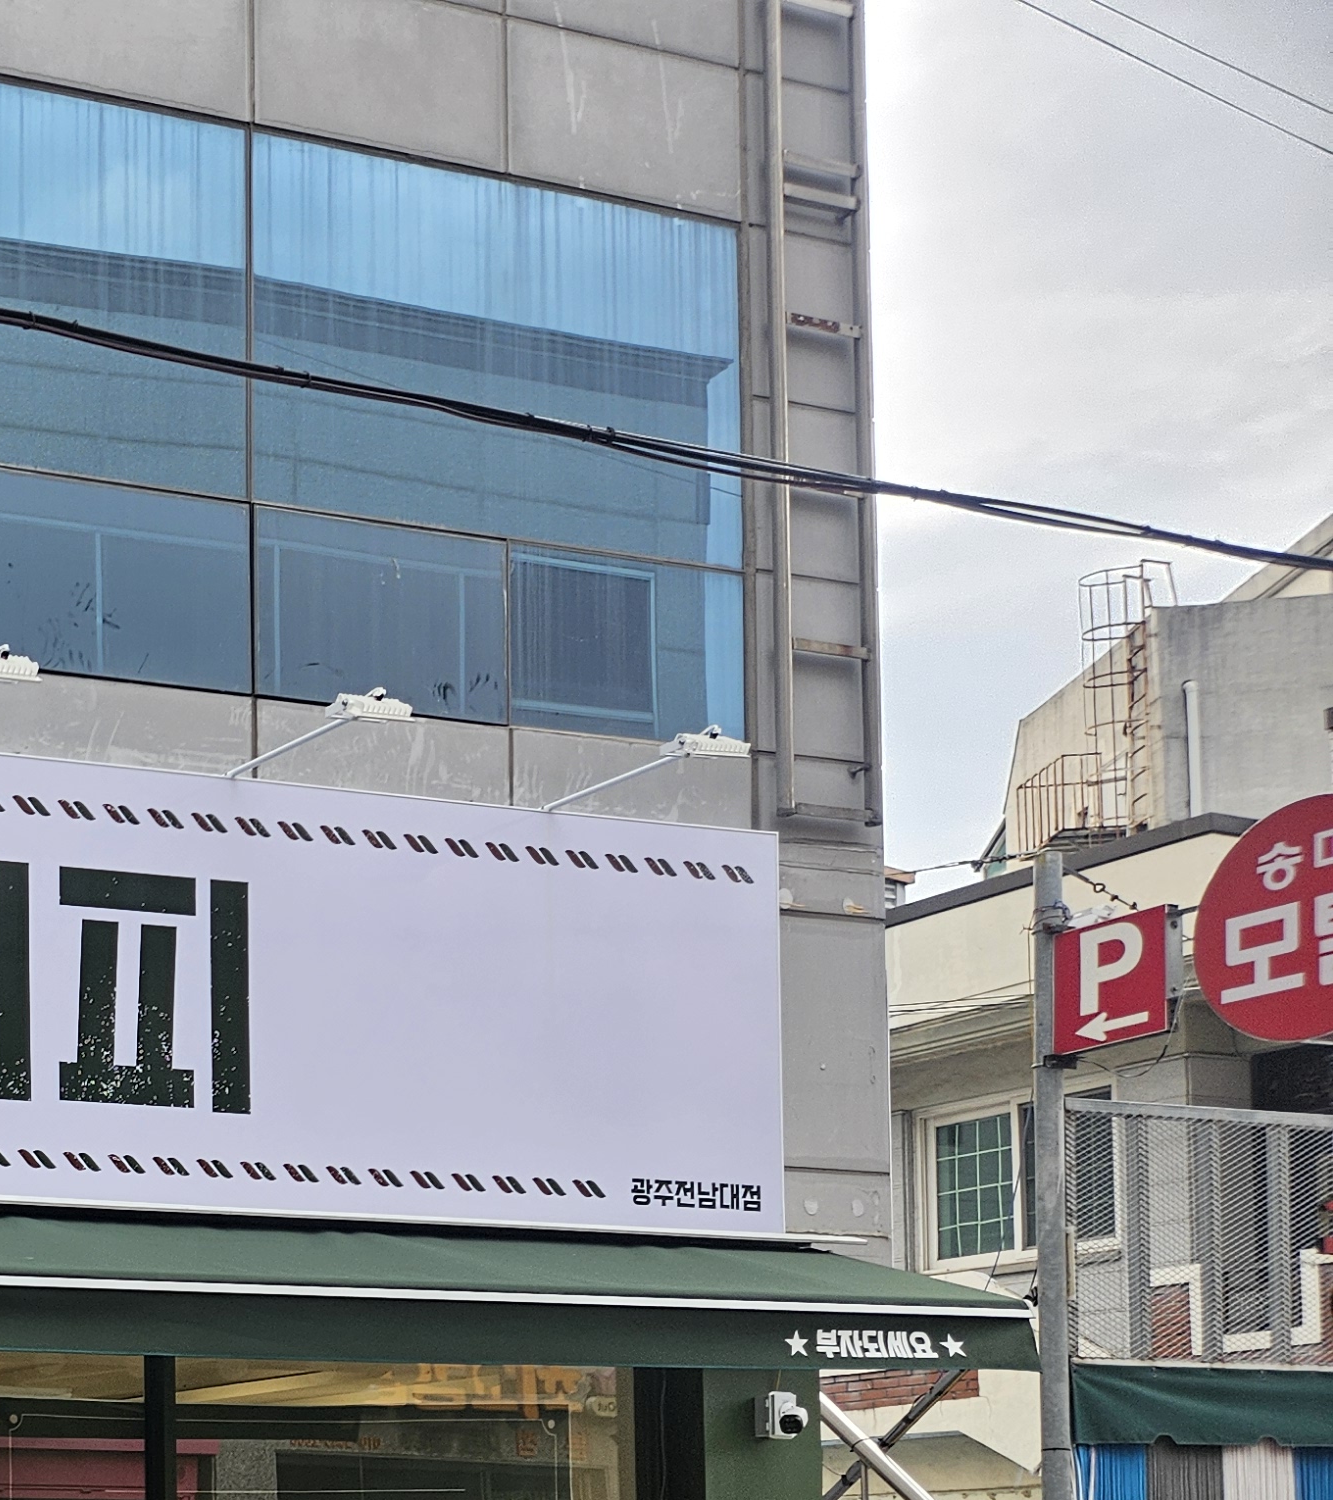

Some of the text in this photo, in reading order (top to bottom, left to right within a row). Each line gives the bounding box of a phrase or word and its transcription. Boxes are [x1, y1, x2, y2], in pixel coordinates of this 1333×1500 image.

[1080, 922, 1143, 1016] P
[631, 1177, 761, 1211] 광주전남대점
[816, 1329, 939, 1359] 부자되세요
